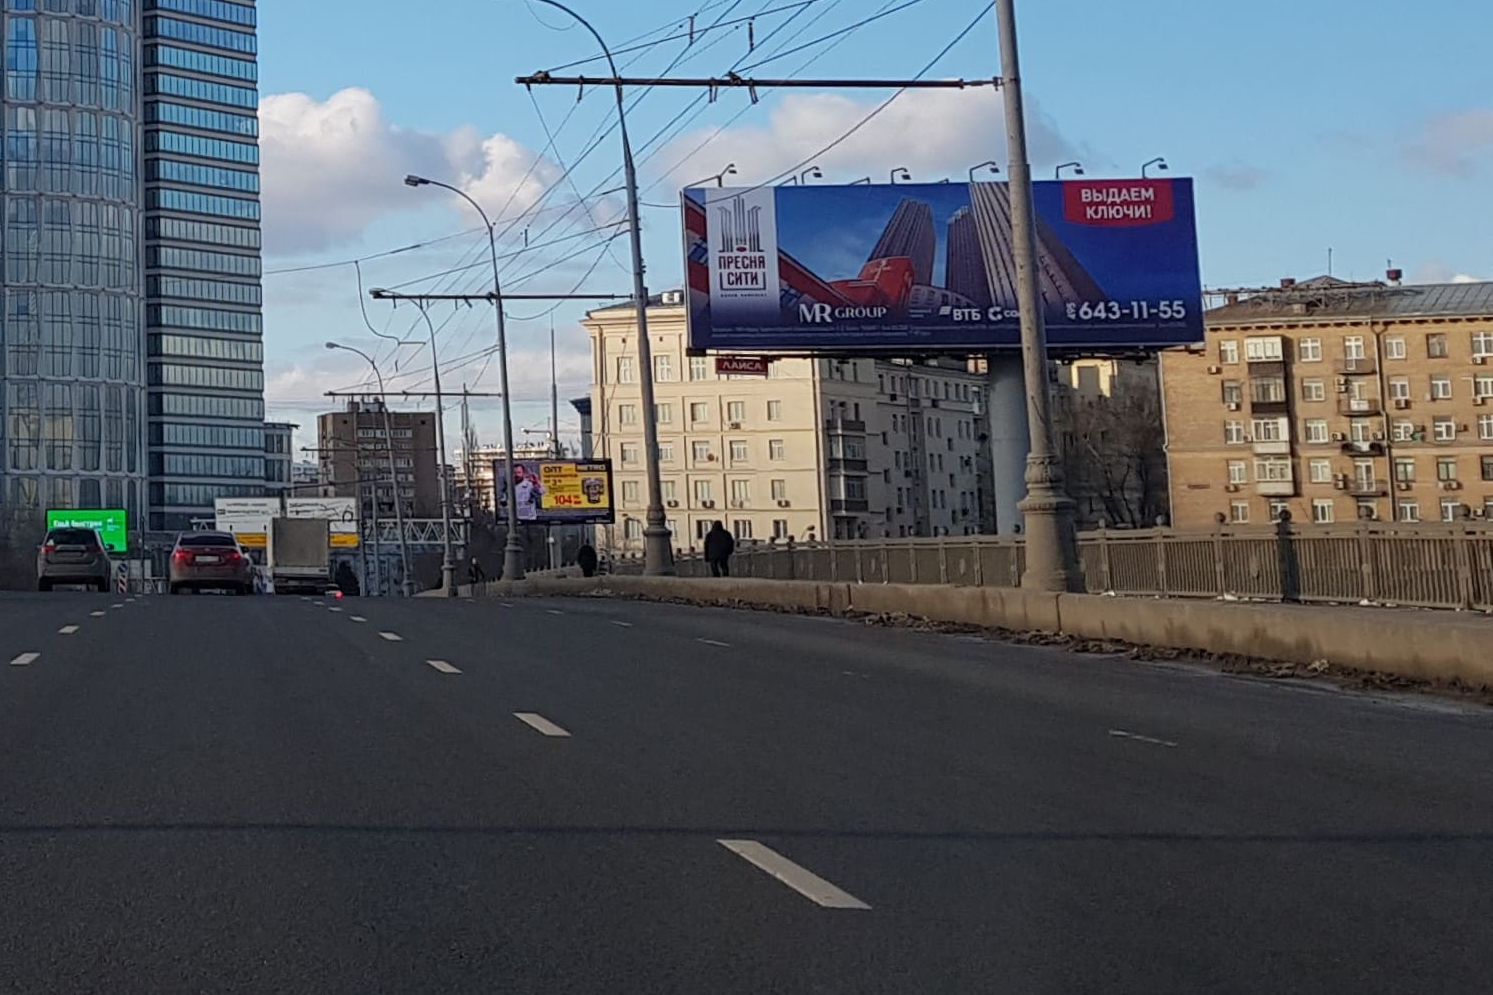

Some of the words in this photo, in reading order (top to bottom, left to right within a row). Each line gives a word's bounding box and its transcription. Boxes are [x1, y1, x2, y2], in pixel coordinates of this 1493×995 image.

[1081, 187, 1154, 203] ВЫДАЕМ
[1086, 205, 1152, 219] КЛЮЧИ!
[718, 255, 766, 270] ПРЕСНЯ
[727, 271, 759, 286] СИТИ
[799, 304, 833, 323] MR
[835, 307, 887, 319] GROUP
[955, 309, 981, 321] ВТБ
[1079, 300, 1186, 320] 643-11-55
